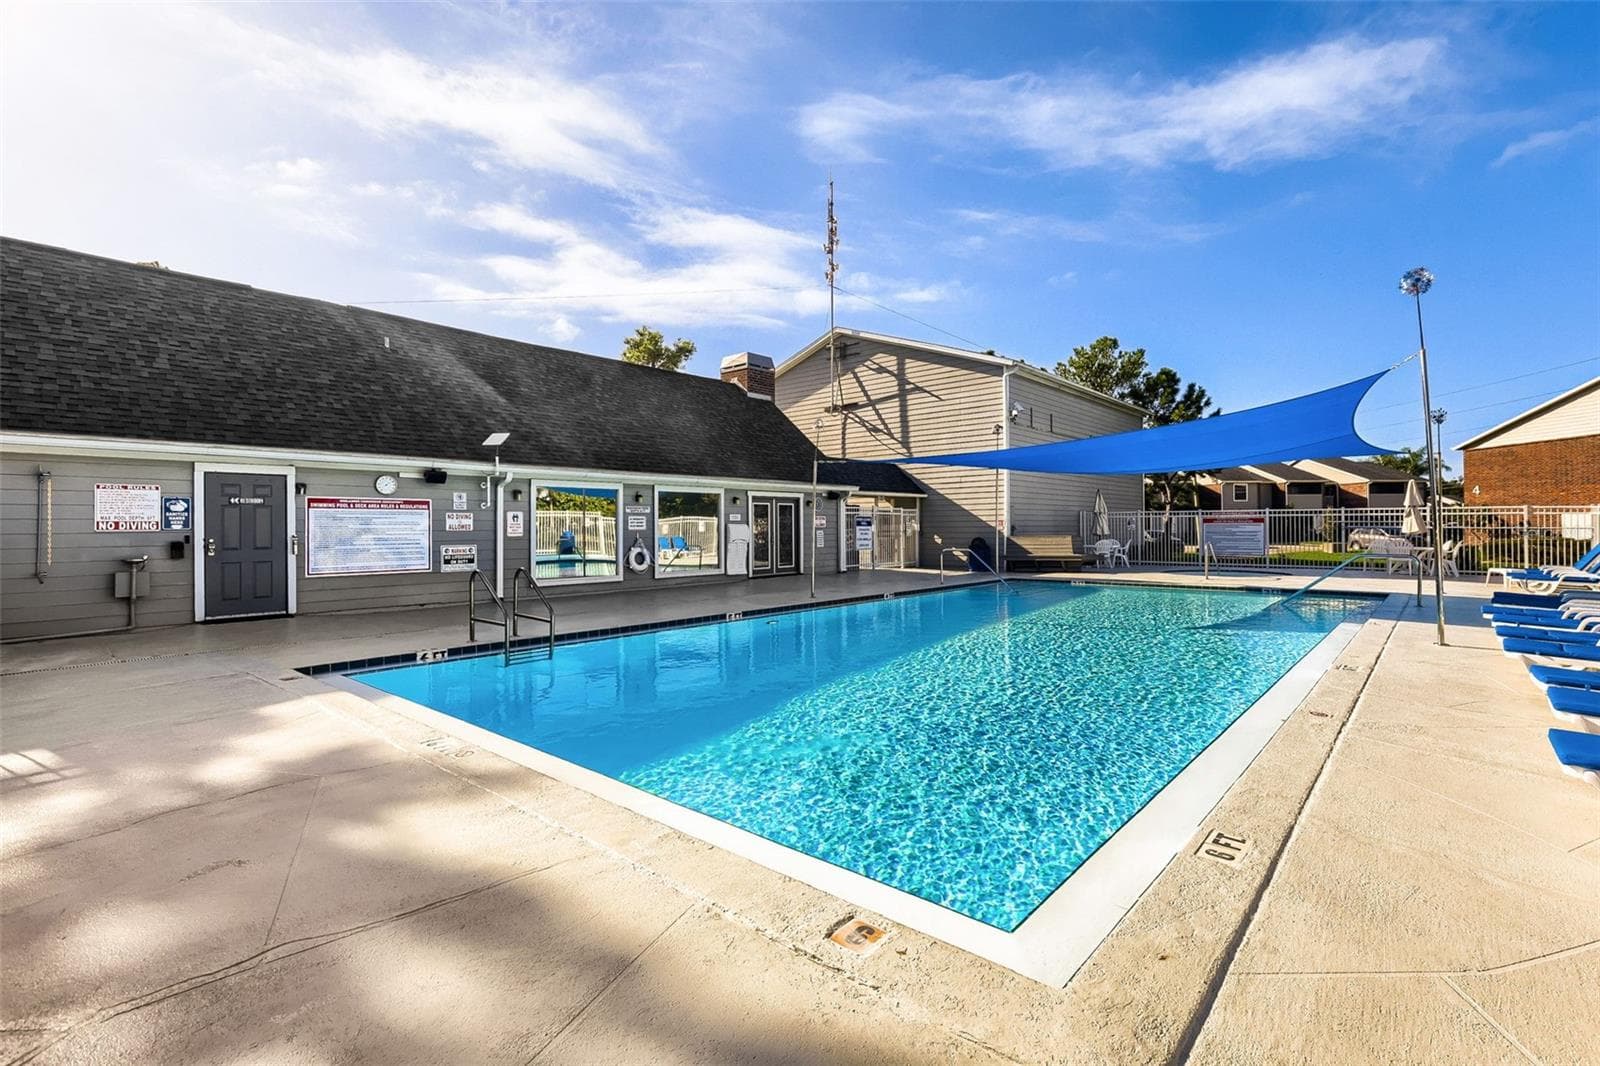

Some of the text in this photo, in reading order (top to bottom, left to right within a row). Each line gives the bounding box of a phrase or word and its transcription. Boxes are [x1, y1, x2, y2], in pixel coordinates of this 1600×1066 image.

[1471, 485, 1480, 496] 4
[99, 521, 157, 530] NO DIVING
[1204, 832, 1247, 861] 6 FT
